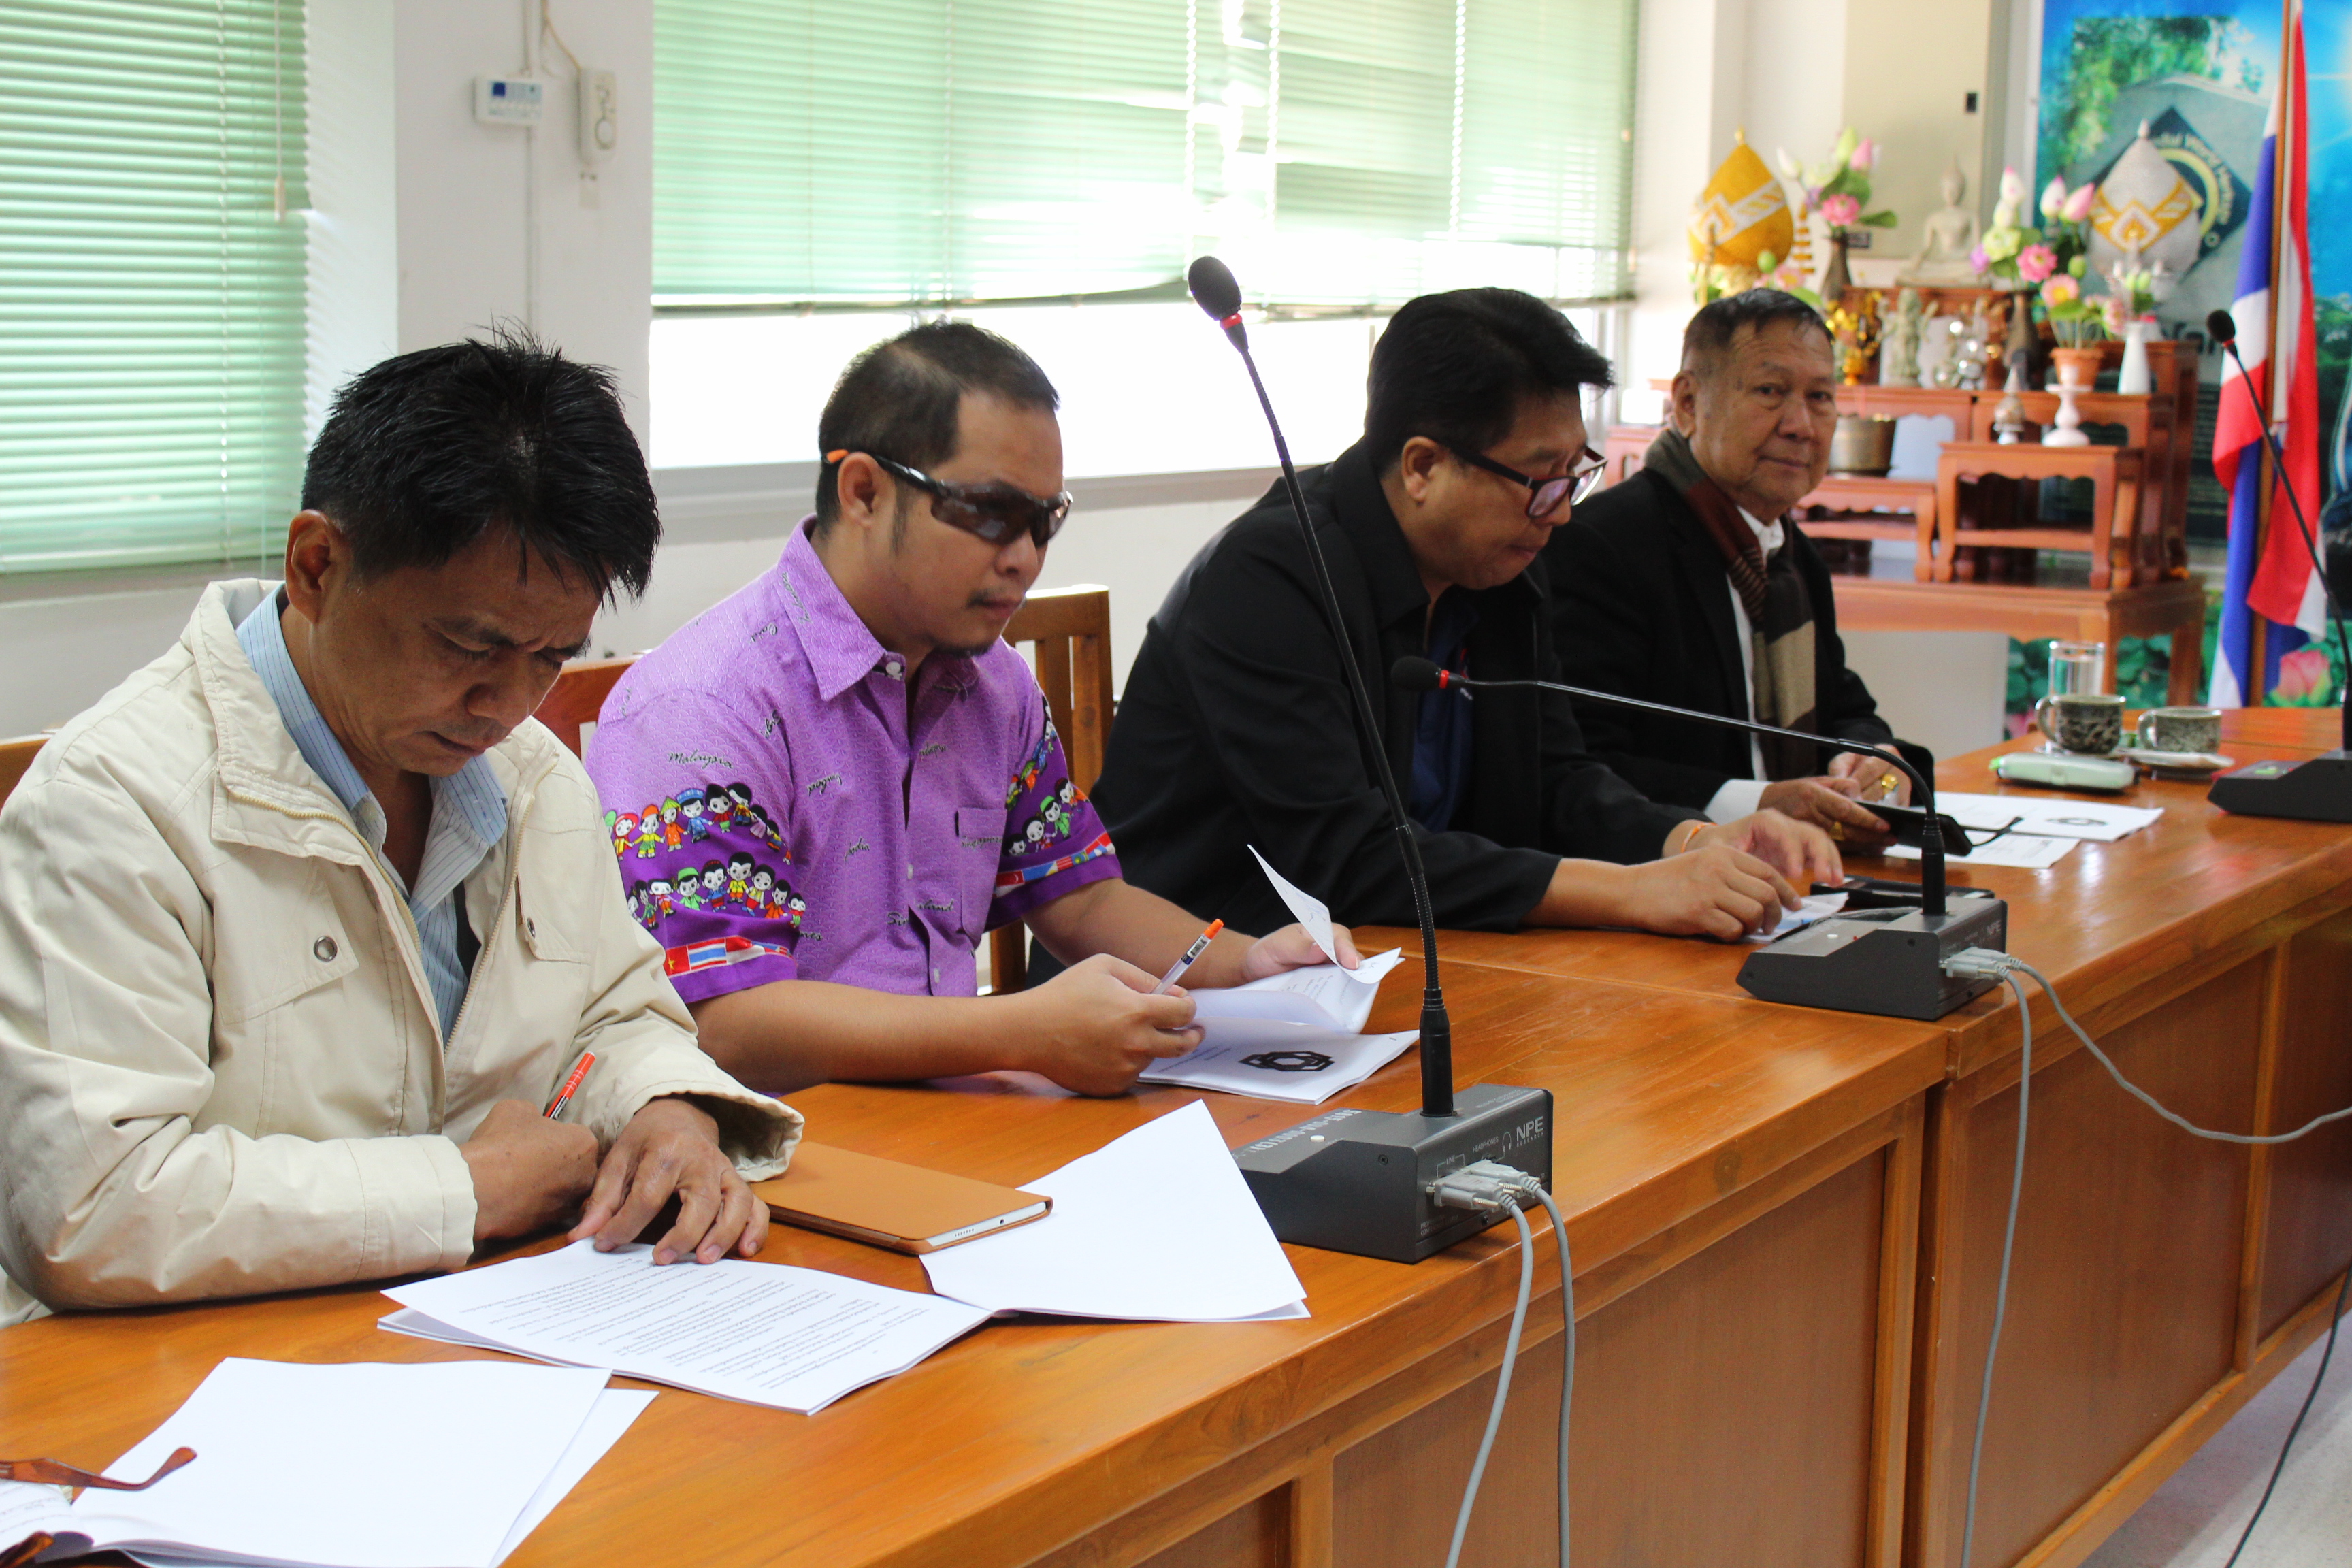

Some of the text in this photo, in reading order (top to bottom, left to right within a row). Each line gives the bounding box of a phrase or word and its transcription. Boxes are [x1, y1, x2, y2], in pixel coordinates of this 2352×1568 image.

[668, 749, 733, 769] Malaysia
[1516, 1115, 1544, 1142] NPE
[1472, 1135, 1499, 1154] HEADPHONES
[1516, 1131, 1545, 1148] RESEARCH
